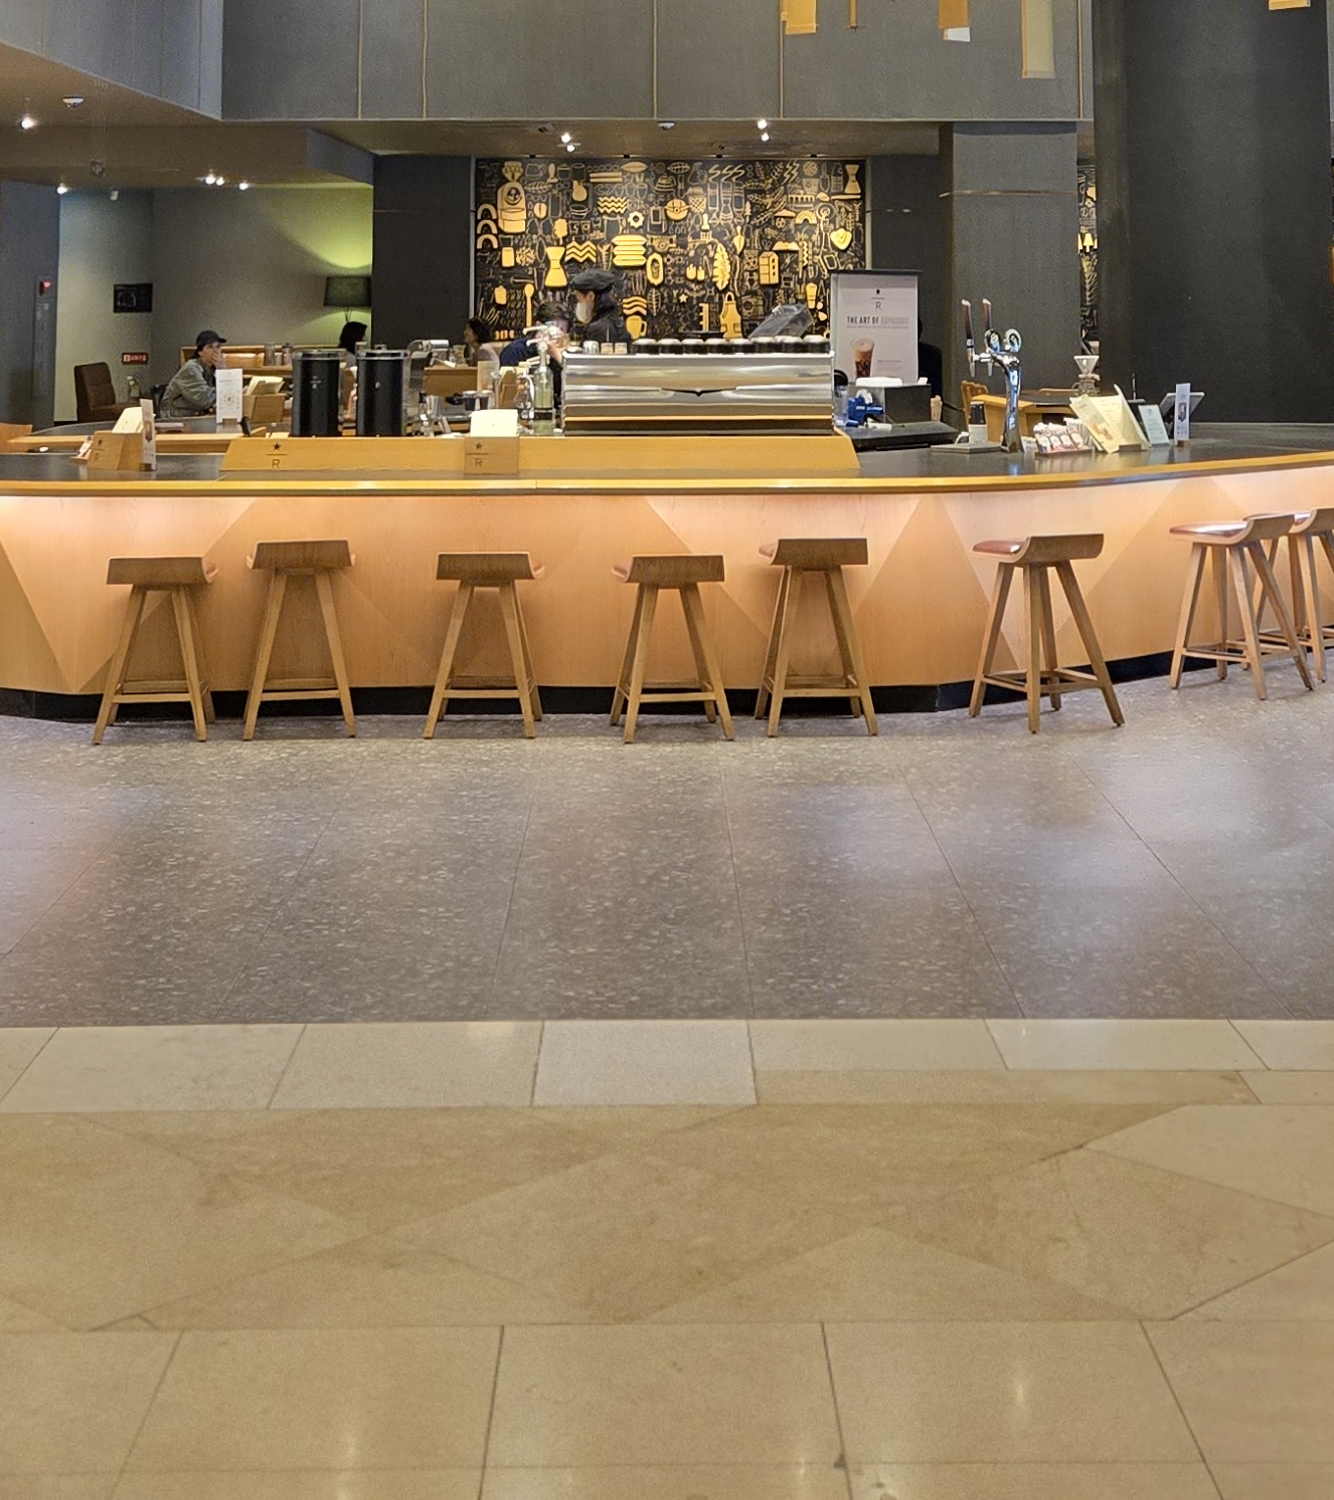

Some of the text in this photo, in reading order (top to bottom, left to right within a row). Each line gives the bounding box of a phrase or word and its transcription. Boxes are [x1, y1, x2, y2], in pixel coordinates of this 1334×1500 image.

[875, 301, 882, 310] R
[847, 316, 858, 325] THE
[859, 316, 871, 325] ART
[872, 316, 879, 325] OF
[271, 458, 281, 469] R
[474, 457, 483, 467] R
